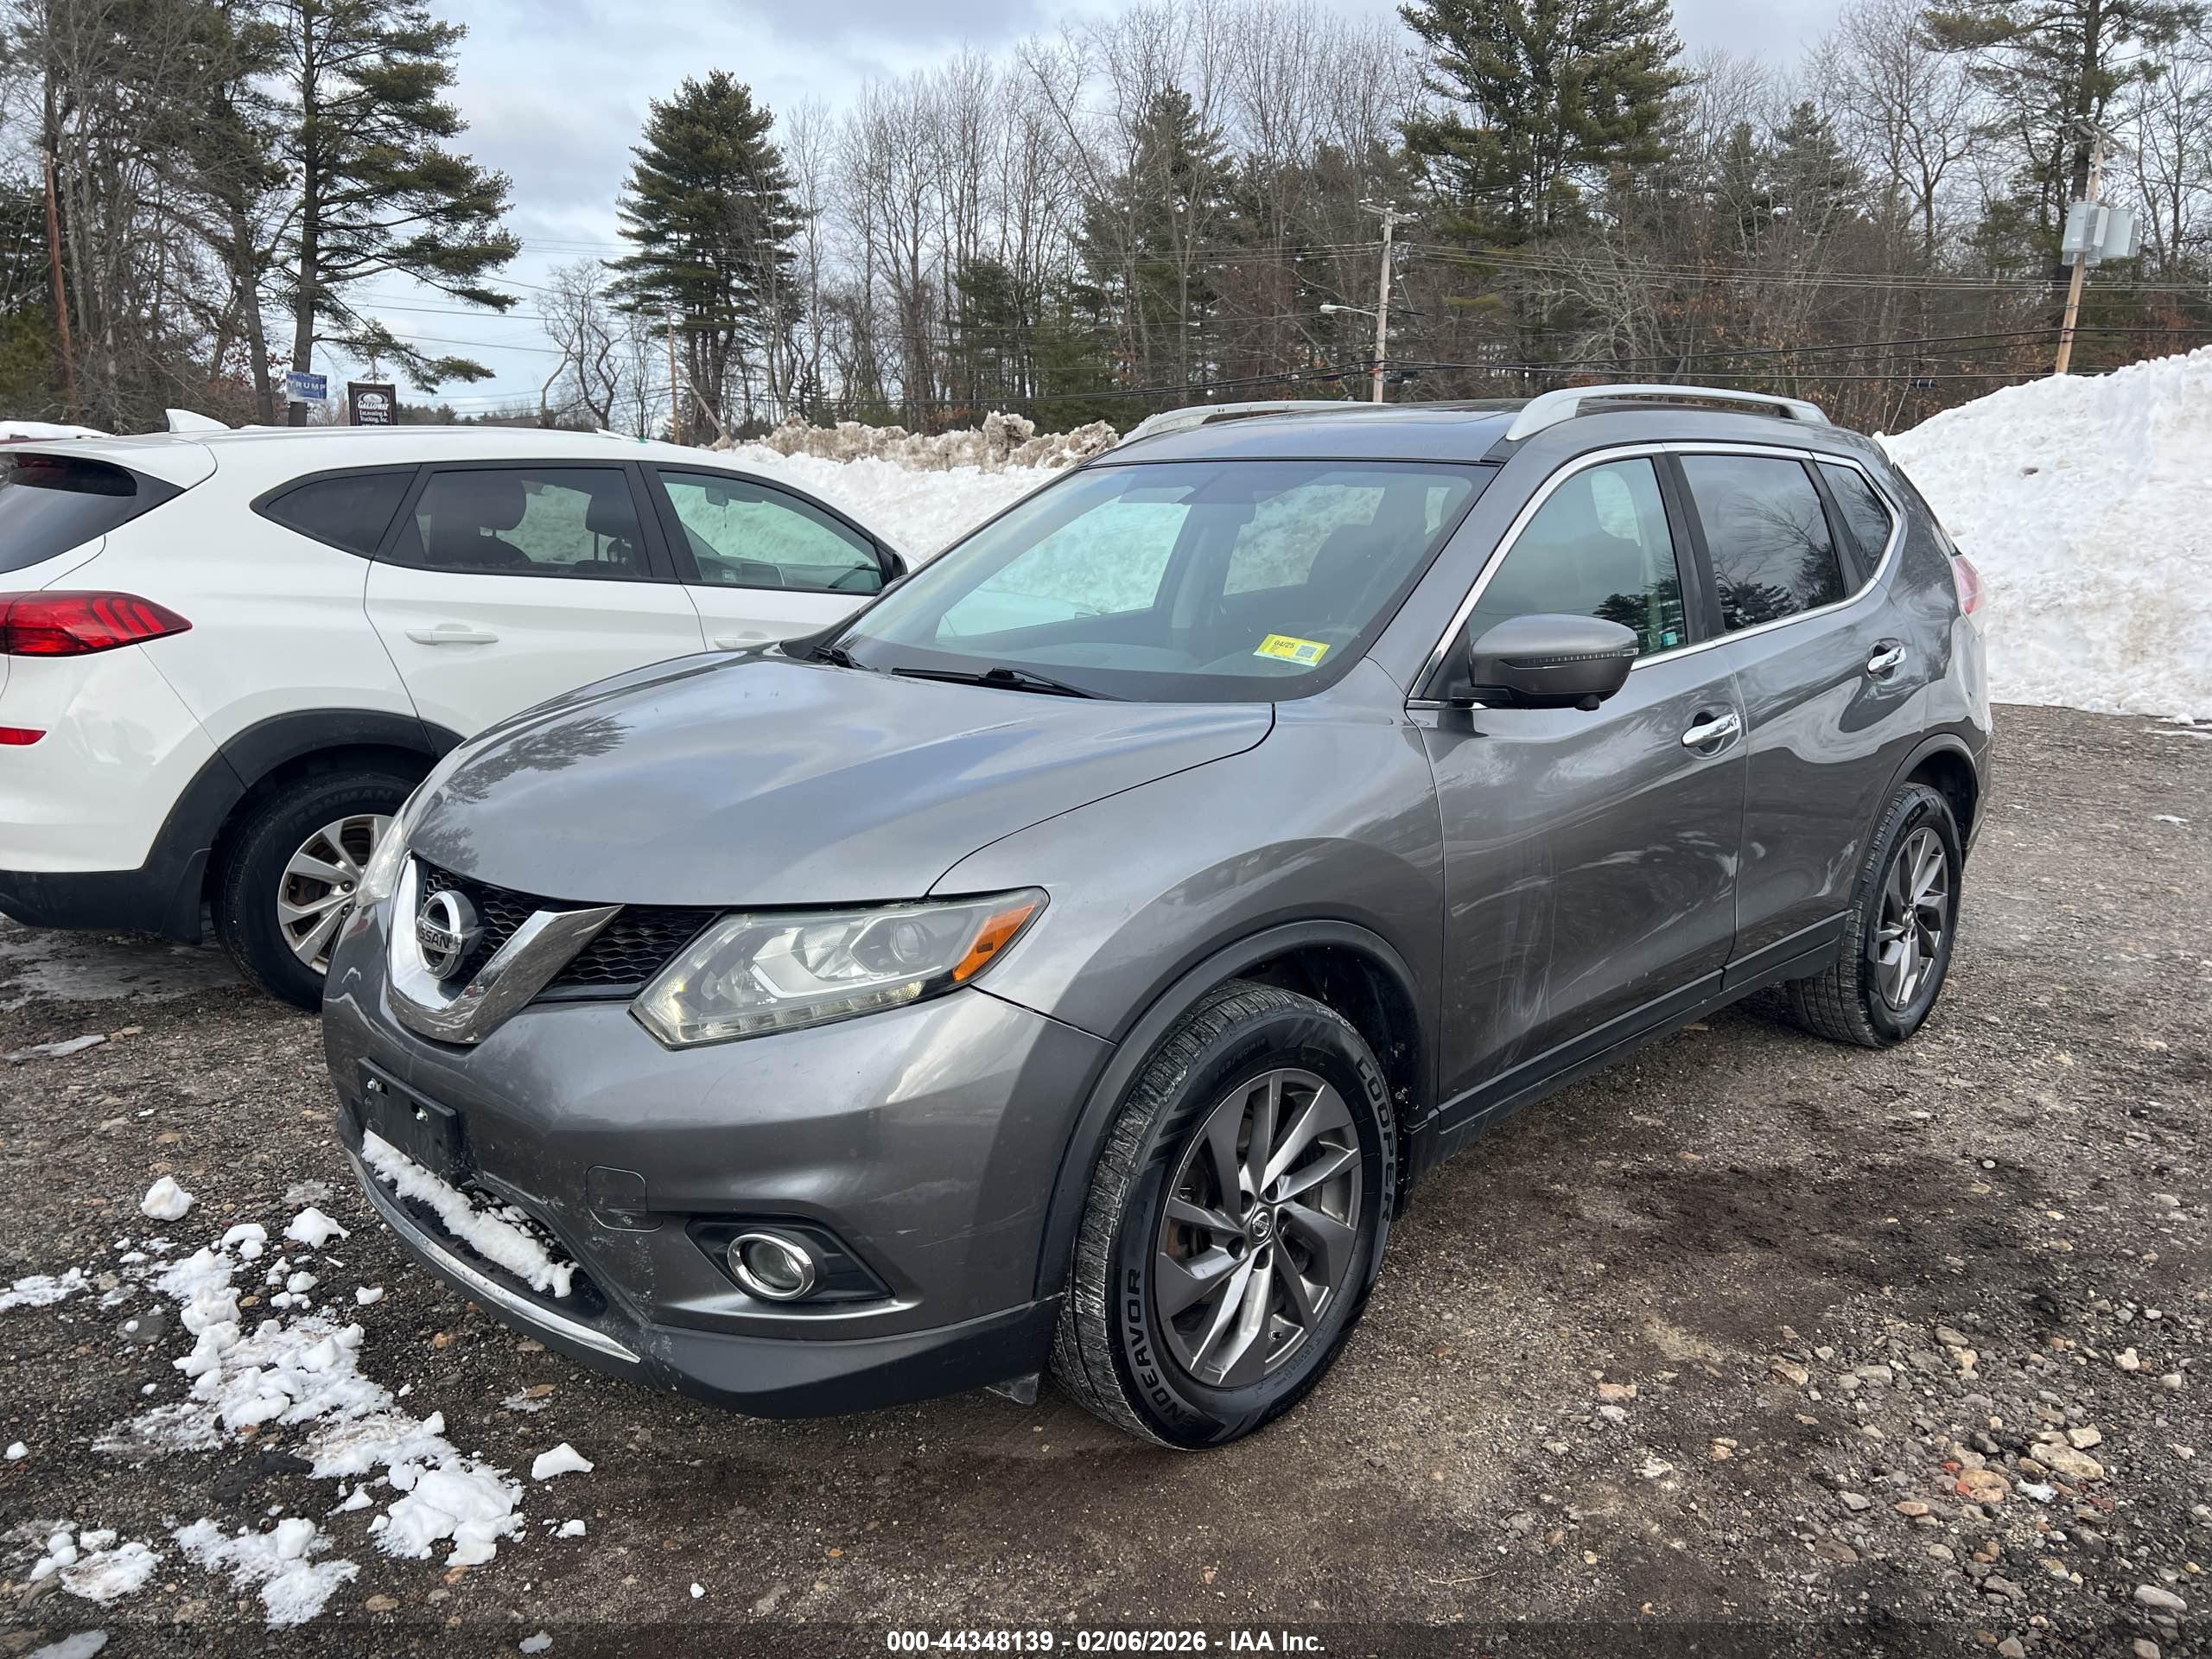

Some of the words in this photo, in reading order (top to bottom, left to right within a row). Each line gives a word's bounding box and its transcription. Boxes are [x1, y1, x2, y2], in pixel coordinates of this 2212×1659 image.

[289, 380, 326, 390] TRUMP
[358, 401, 389, 410] GALLOWAY
[288, 789, 394, 830] IRONMAN
[1356, 1056, 1394, 1222] COOPER
